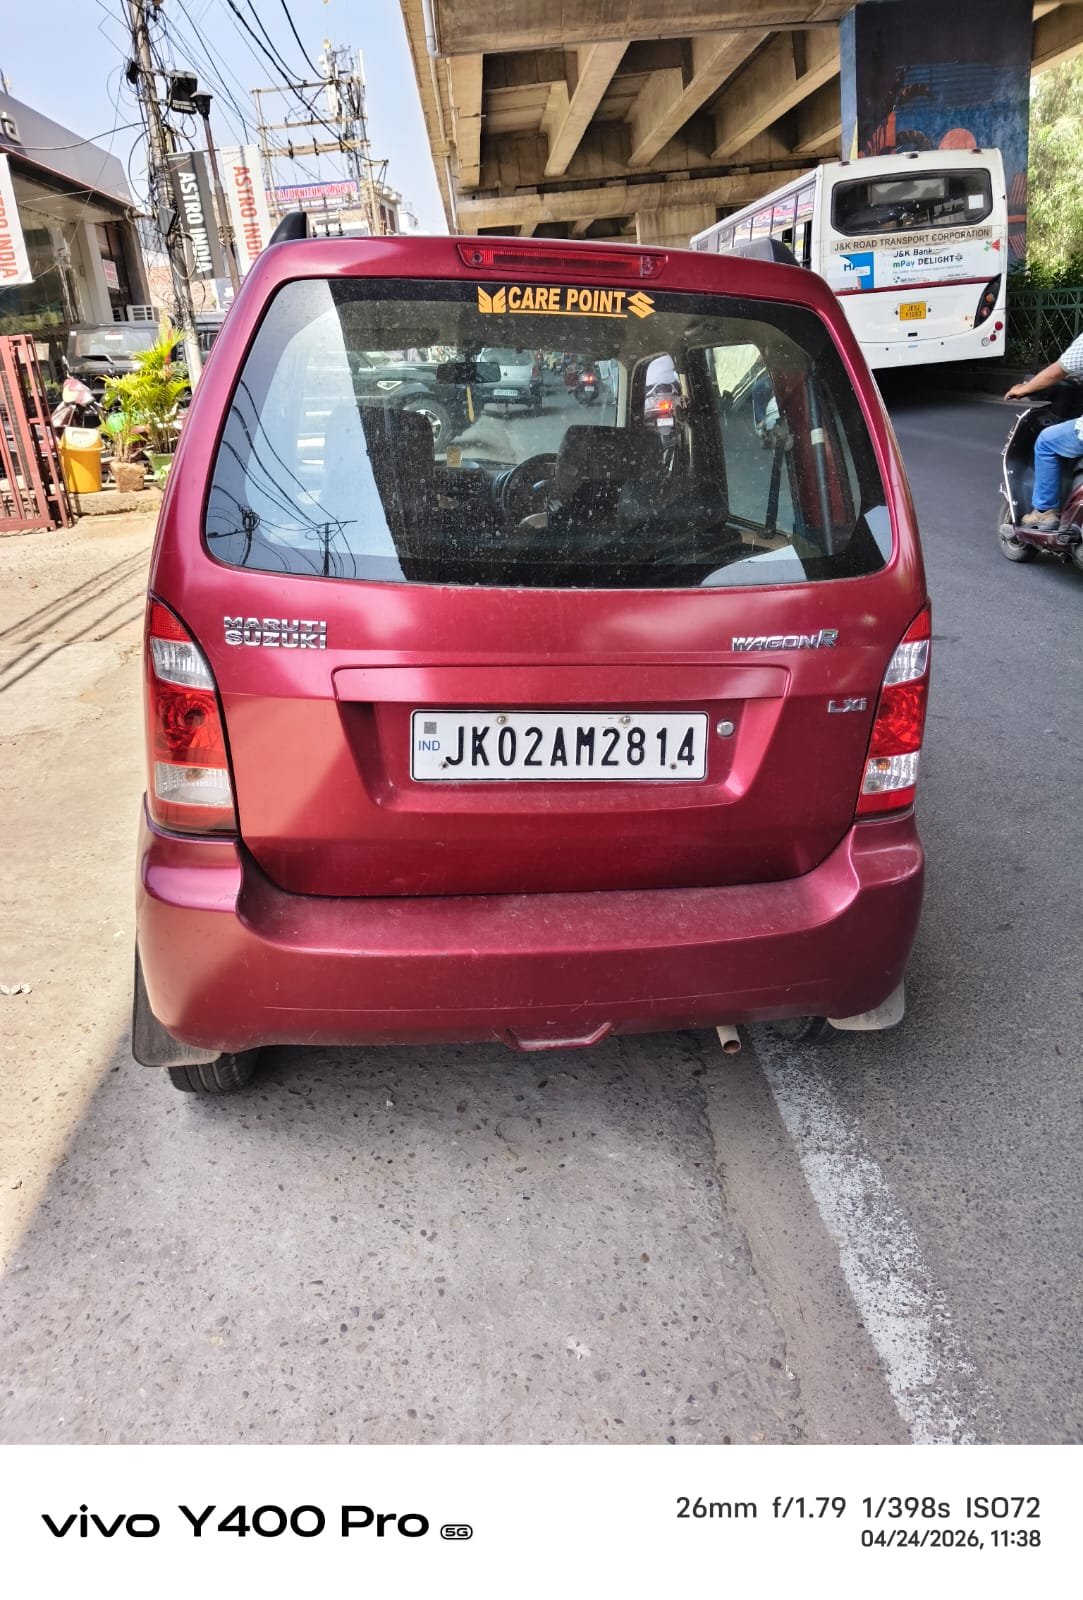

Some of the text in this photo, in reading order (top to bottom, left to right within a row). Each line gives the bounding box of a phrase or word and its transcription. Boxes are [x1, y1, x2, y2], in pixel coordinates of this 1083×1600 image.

[178, 172, 212, 273] ASTRO INDIA
[233, 166, 263, 259] ASTRO INDI
[834, 229, 990, 252] J&K ROAD TRANSPORT CORPORATION
[0, 233, 19, 279] INDIA
[893, 247, 932, 258] J&K Bank
[893, 254, 954, 269] mPay DELIGHT
[508, 286, 626, 313] CARE POINT
[223, 616, 327, 633] MARUTI
[224, 630, 327, 649] SUZUKI
[418, 740, 441, 752] IND
[445, 726, 695, 767] JK02AM2814
